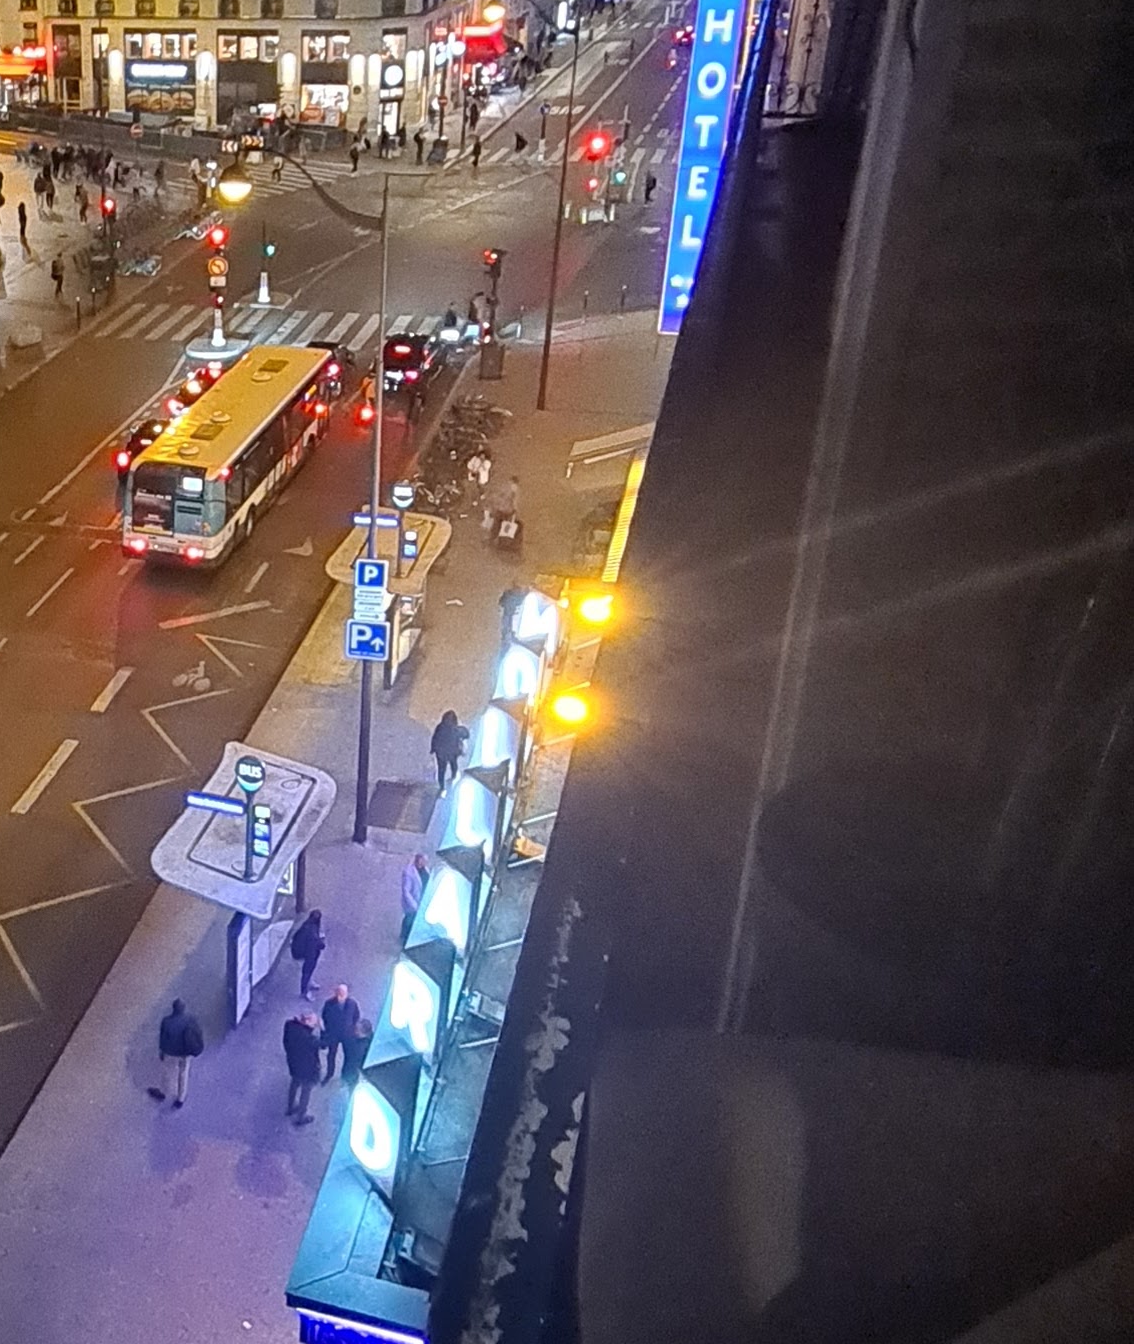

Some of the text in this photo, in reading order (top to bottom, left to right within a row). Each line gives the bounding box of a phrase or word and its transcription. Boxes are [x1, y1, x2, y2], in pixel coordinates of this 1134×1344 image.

[364, 565, 379, 583] P
[351, 624, 373, 649] P
[239, 763, 262, 779] BUS
